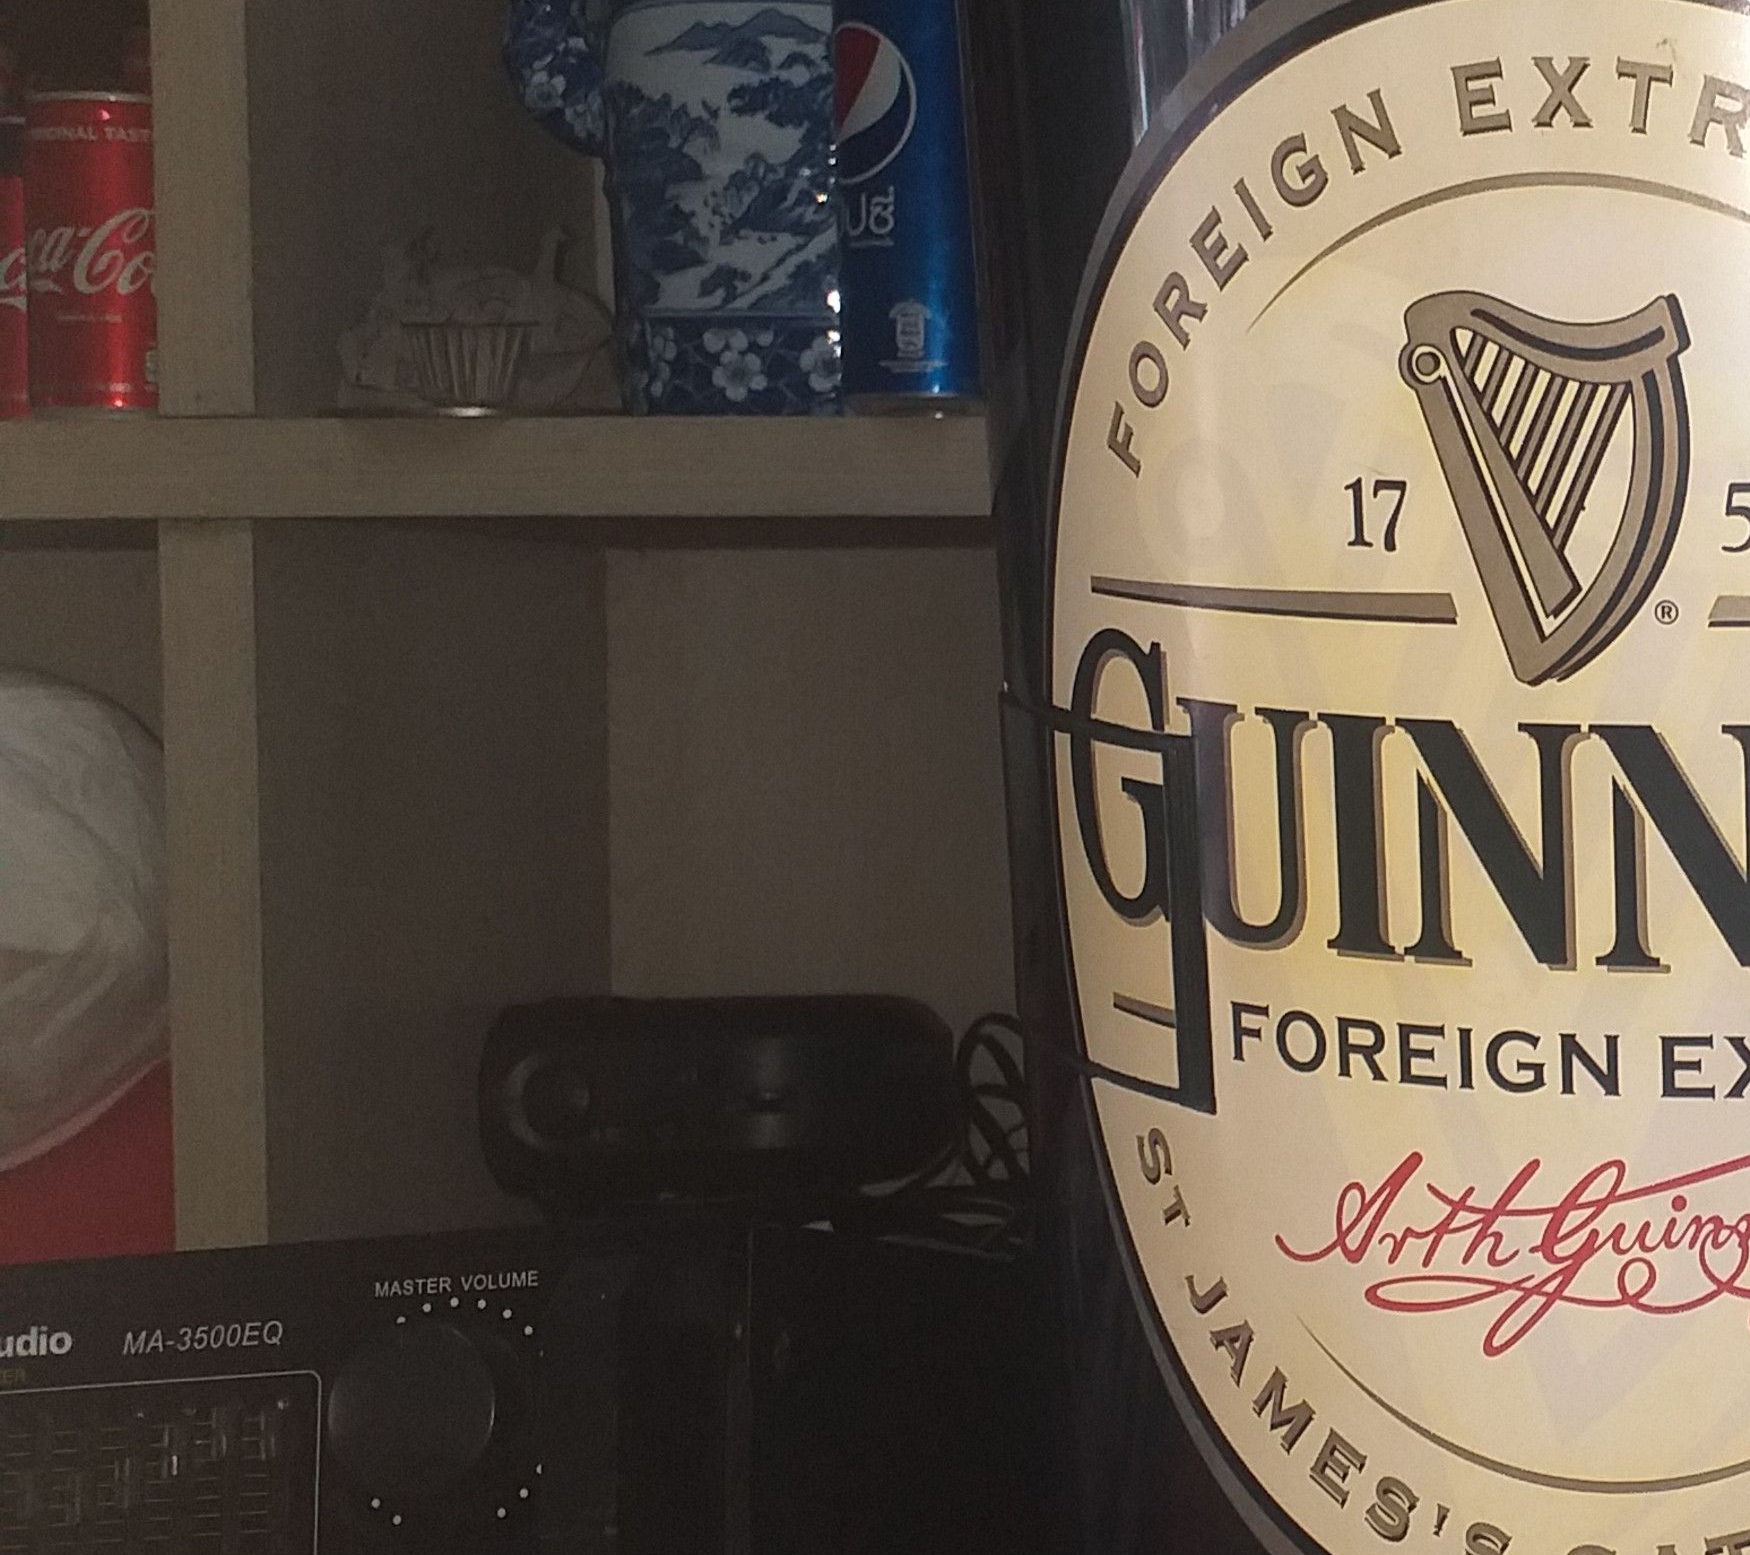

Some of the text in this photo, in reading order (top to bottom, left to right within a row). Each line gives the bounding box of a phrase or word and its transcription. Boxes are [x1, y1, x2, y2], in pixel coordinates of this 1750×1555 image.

[1107, 88, 1402, 477] FOREIGN
[1344, 475, 1408, 553] 17
[1229, 1000, 1621, 1097] FOREIGN
[1136, 1127, 1192, 1228] ST
[1275, 1150, 1541, 1268] Arth
[374, 1270, 539, 1297] MASTER VOLUME
[121, 1320, 284, 1355] MA-3500EQ
